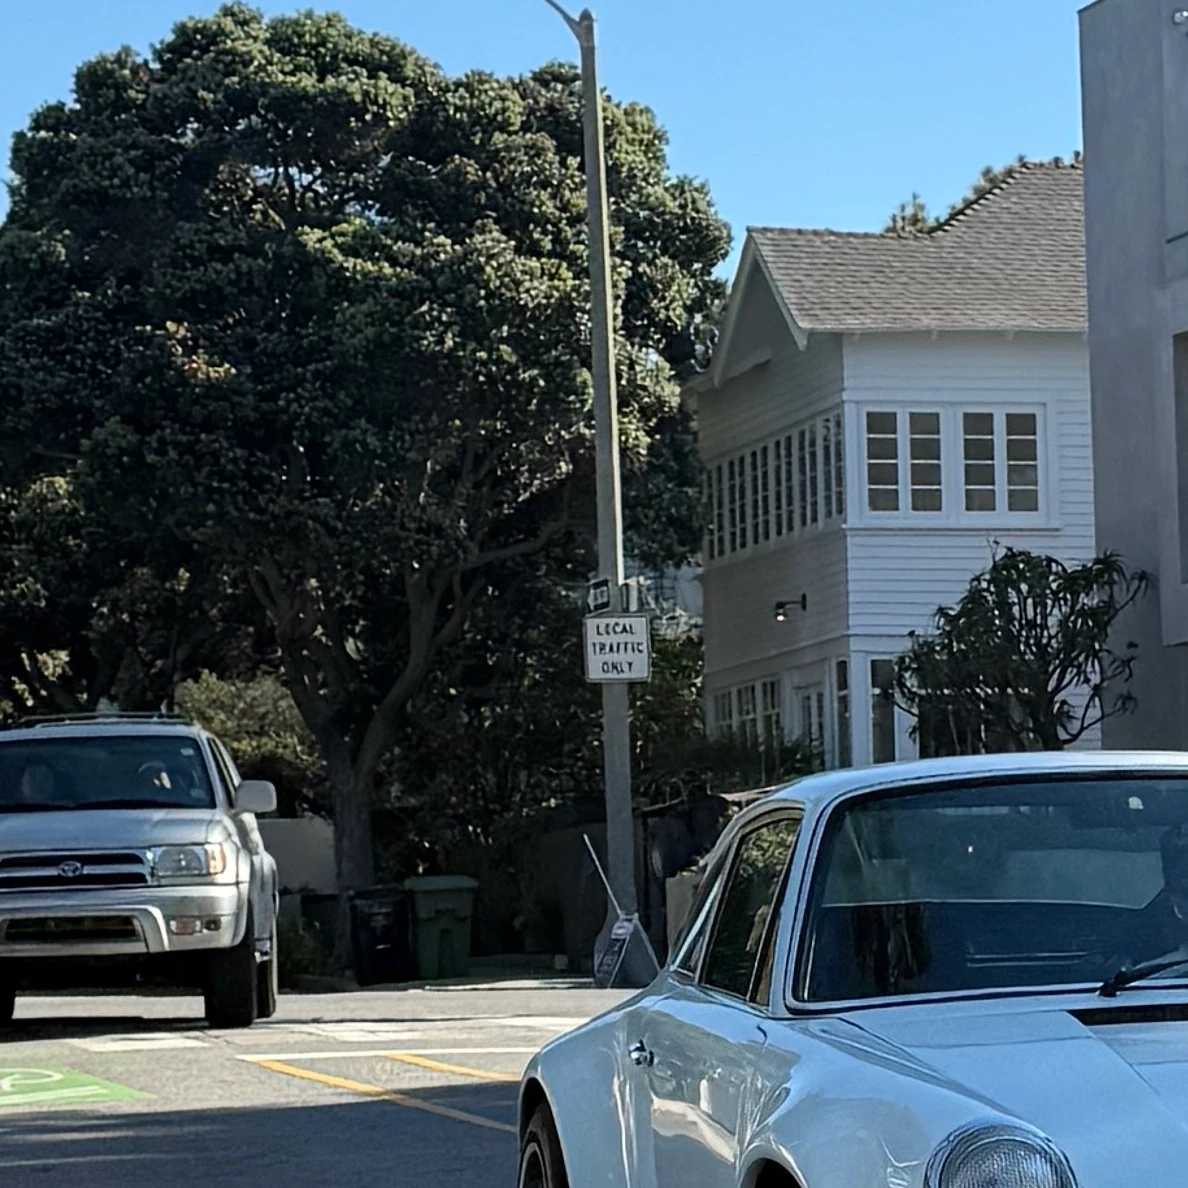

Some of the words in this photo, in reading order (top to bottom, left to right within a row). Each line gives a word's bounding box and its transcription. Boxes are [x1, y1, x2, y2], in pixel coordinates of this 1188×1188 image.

[596, 622, 636, 636] LOCAL
[592, 641, 644, 656] TRAFFIC
[601, 661, 634, 675] ONLY
